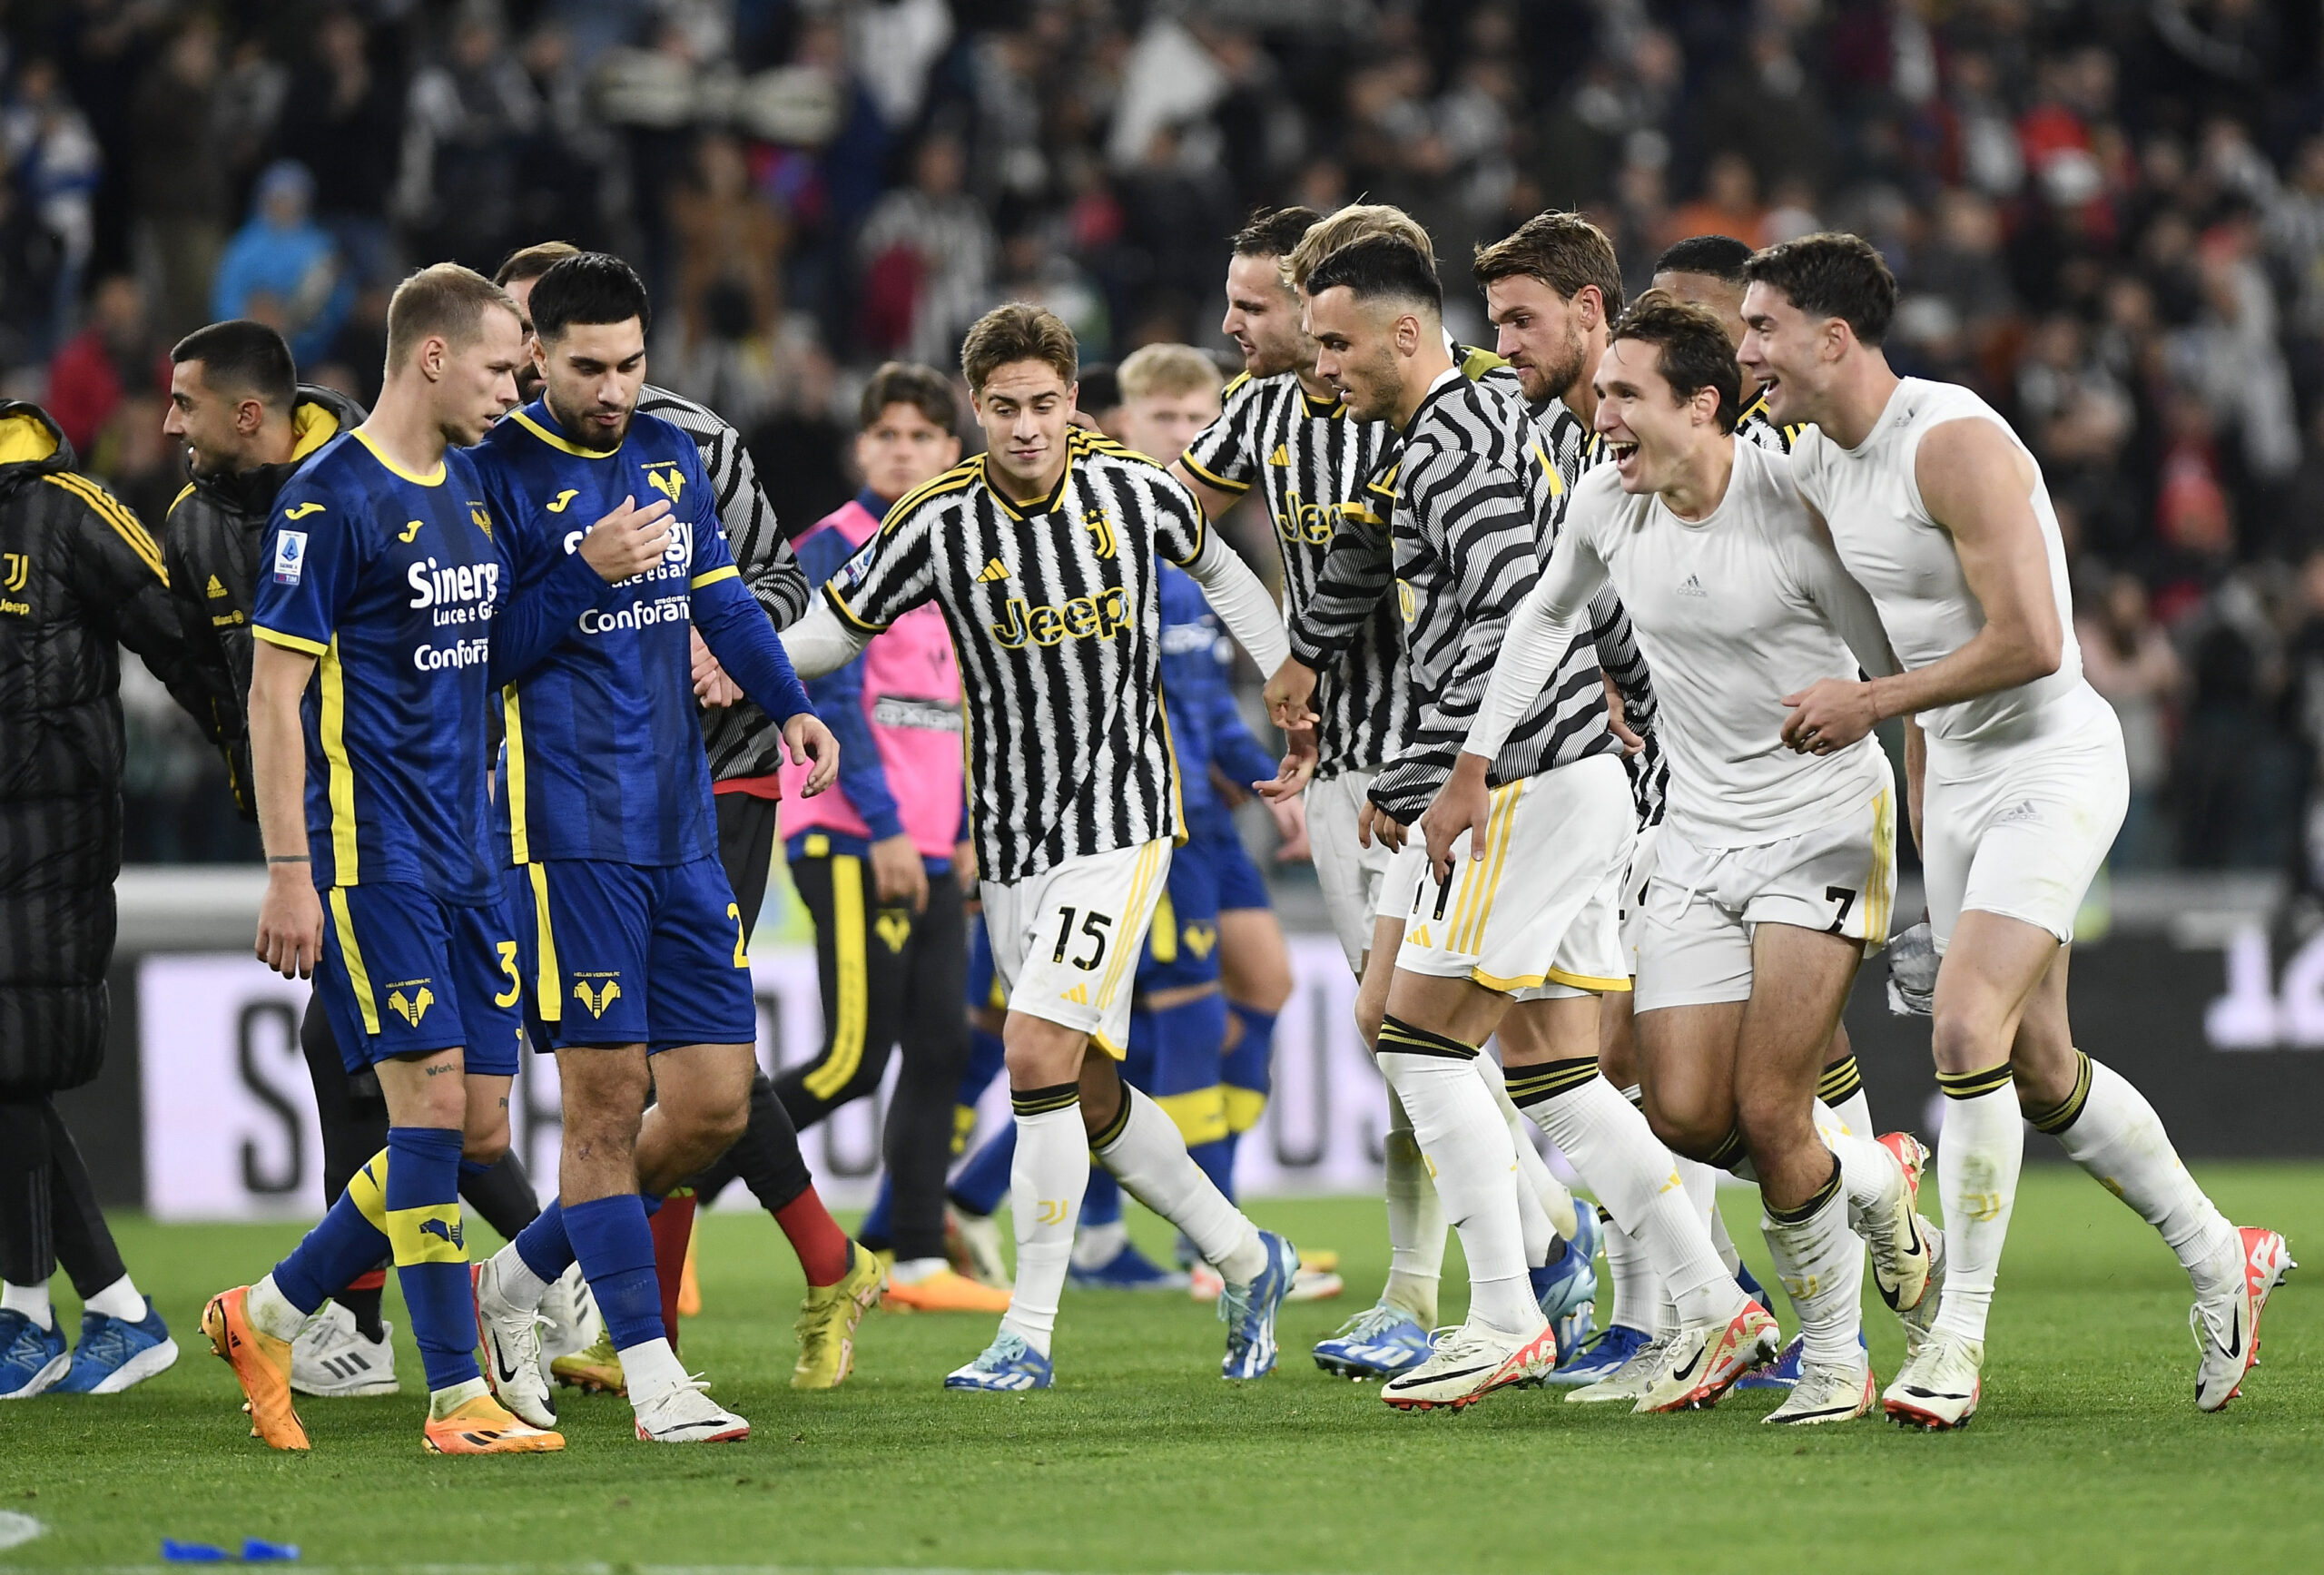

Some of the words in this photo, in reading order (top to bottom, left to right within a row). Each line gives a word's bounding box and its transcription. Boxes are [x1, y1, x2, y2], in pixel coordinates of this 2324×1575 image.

[0, 598, 30, 615] Jeep
[408, 556, 498, 608] Sinerg
[433, 607, 467, 626] Luce
[468, 606, 476, 622] e
[990, 586, 1133, 649] Jeep
[1826, 886, 1856, 932] 7
[1053, 906, 1112, 970] 15
[495, 941, 521, 1008] 3
